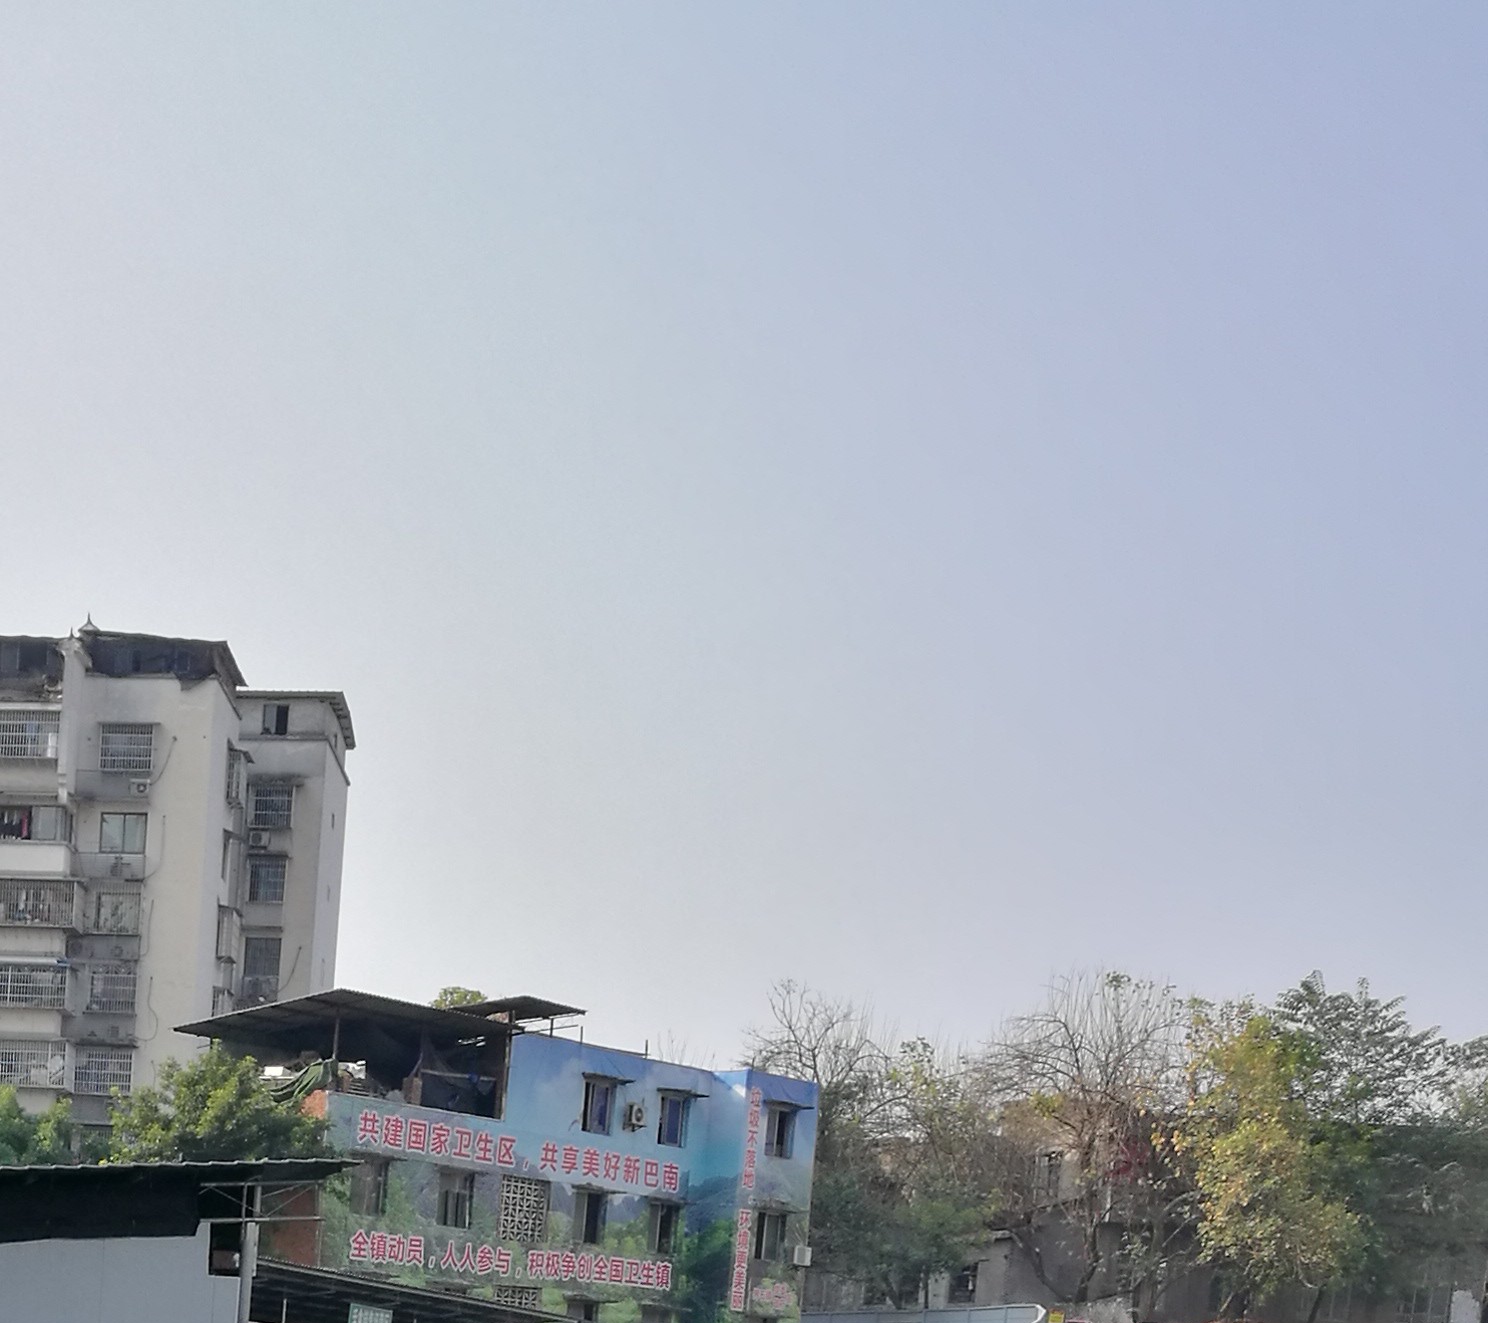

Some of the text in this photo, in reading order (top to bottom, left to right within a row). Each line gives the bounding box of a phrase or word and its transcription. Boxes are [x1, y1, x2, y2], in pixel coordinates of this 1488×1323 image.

[356, 1110, 680, 1194] 共建国家卫生区，共享美好新巴南
[349, 1229, 672, 1291] 全镇动员，人人参与，积极争创全国卫生镇
